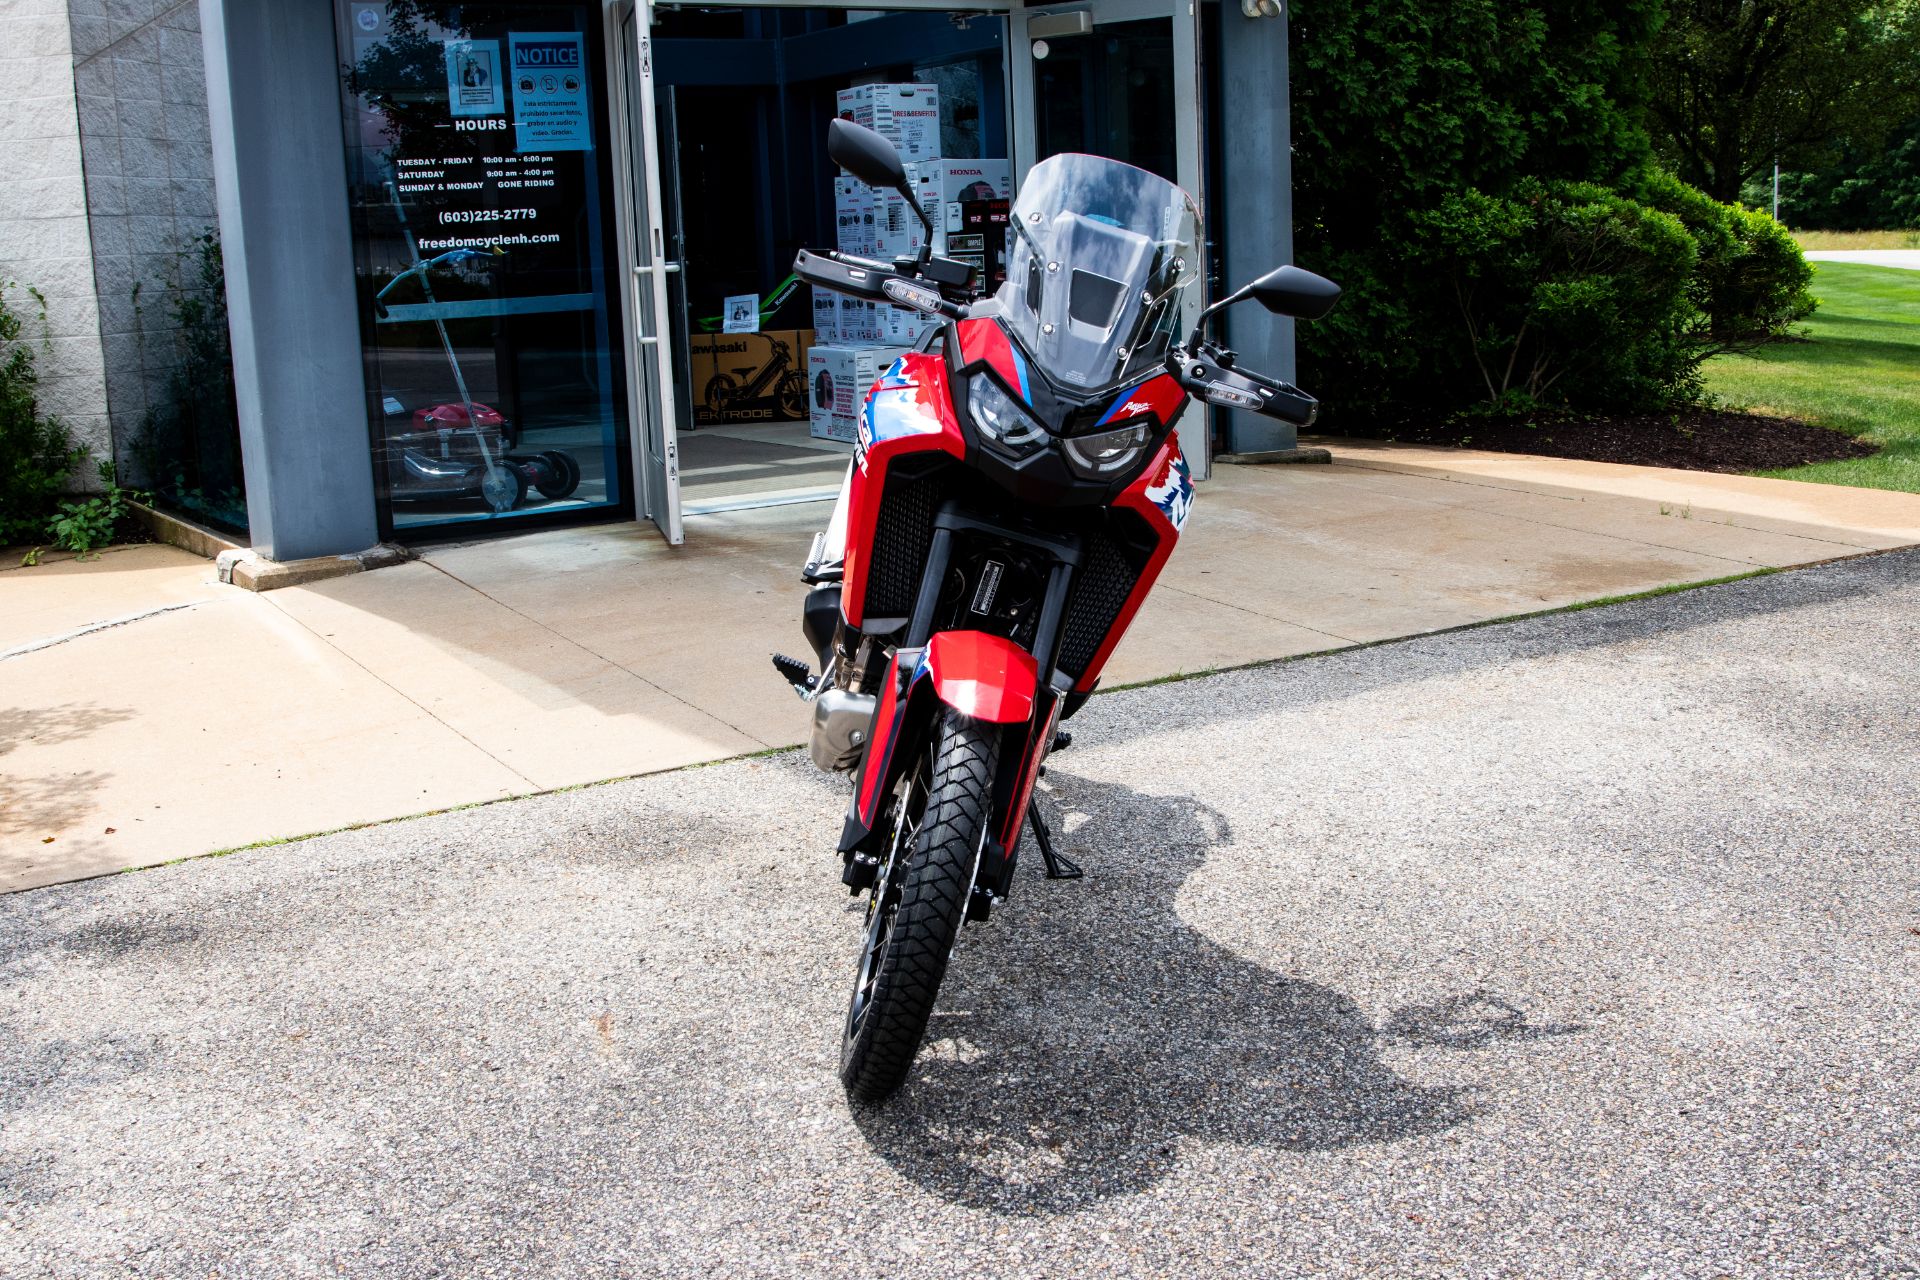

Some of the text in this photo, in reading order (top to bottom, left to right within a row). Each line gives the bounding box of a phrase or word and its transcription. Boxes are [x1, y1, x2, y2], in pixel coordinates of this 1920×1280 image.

[516, 48, 578, 64] NOTICE
[520, 110, 548, 118] prohibido
[455, 119, 507, 131] HOURS
[397, 158, 436, 166] TUESDAY
[443, 157, 473, 165] FRIDAY
[482, 156, 503, 164] 10:00
[541, 156, 553, 164] pm
[398, 171, 445, 179] SATURDAY
[399, 182, 484, 192] SUNDAY & MONDAY
[524, 179, 555, 187] RIDING
[438, 208, 537, 224] (603)225-2779
[418, 233, 560, 249] freedomcyclenh.com
[775, 282, 798, 306] Kawasaki
[692, 341, 747, 354] awasaki
[696, 409, 773, 420] EKTRODE
